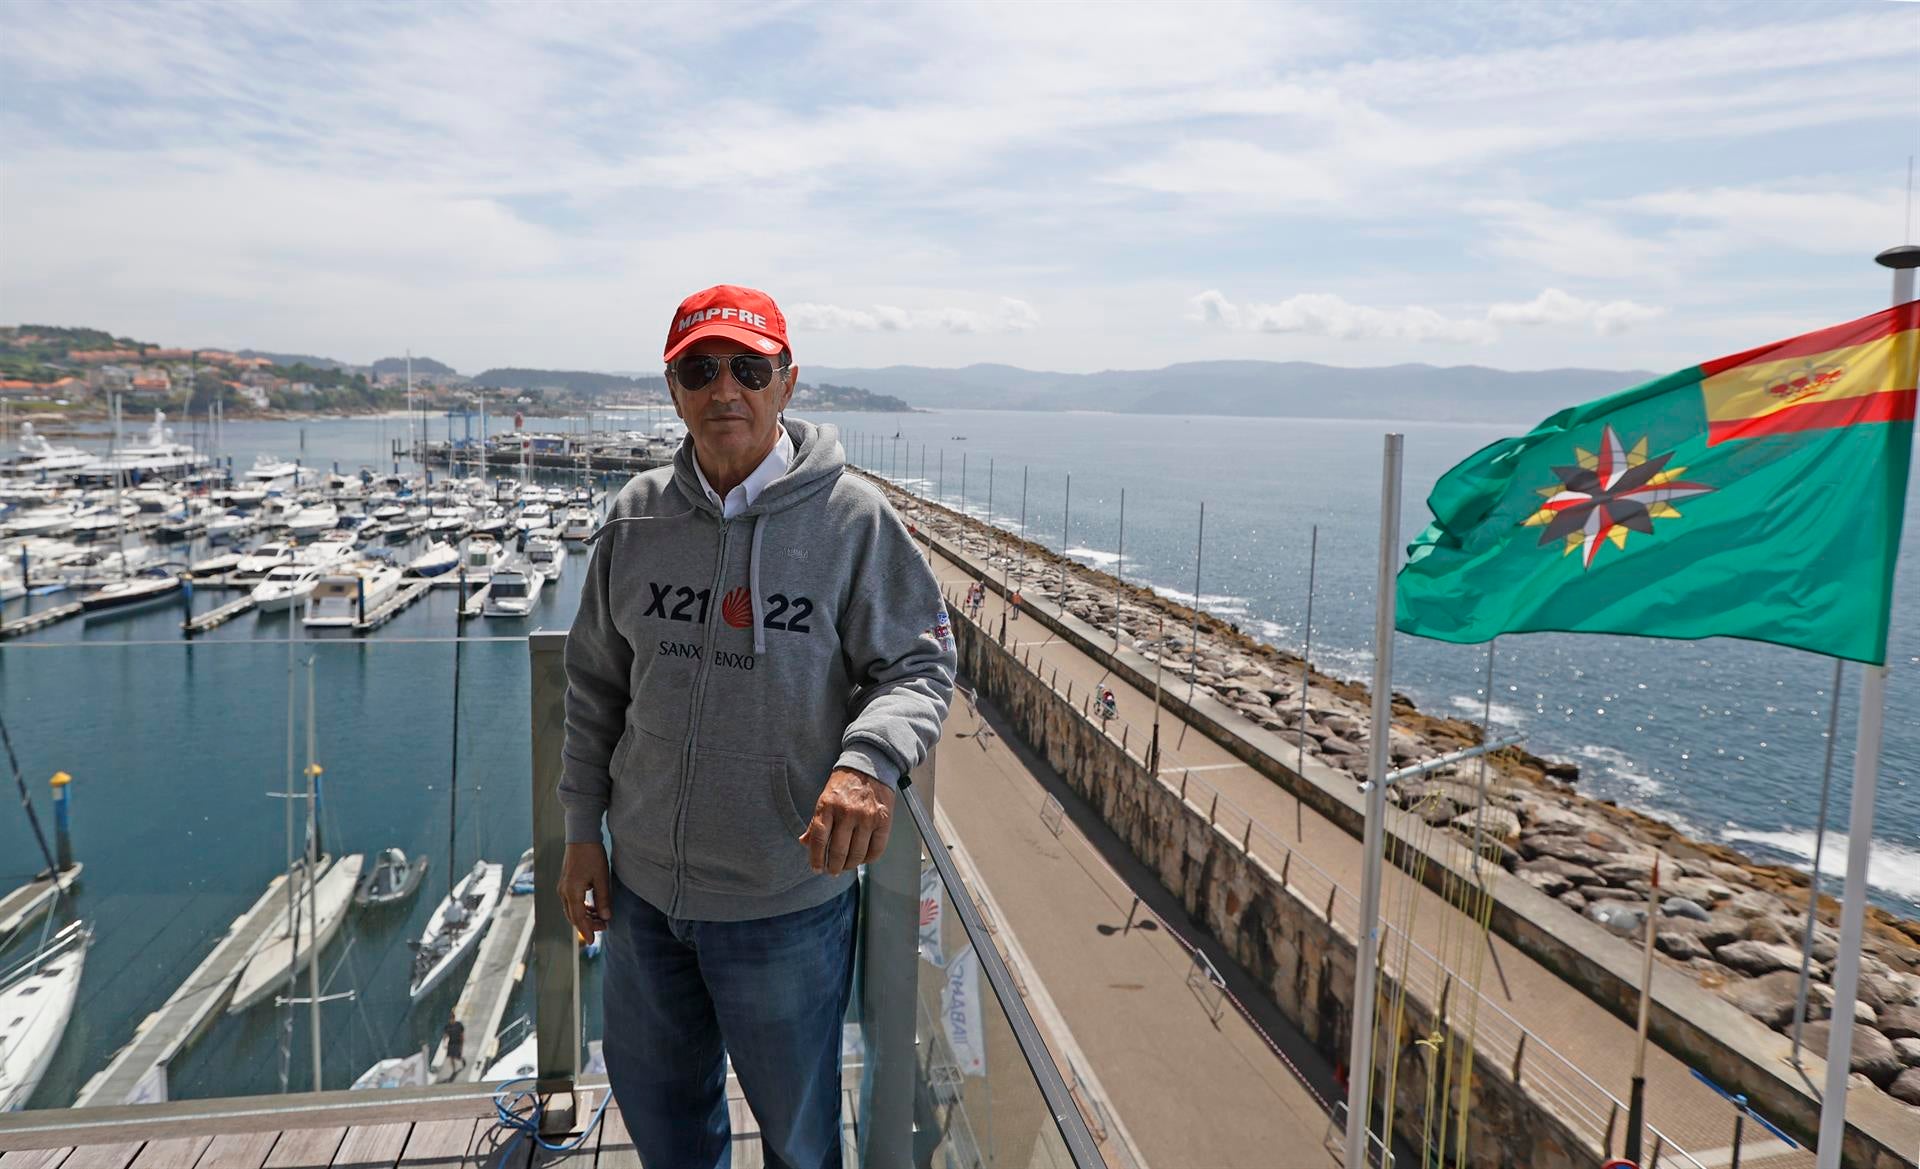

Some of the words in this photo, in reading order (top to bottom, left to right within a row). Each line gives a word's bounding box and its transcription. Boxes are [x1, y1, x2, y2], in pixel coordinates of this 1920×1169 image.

[678, 307, 767, 332] MAPFRE
[643, 582, 711, 625] X21
[763, 593, 814, 634] 22
